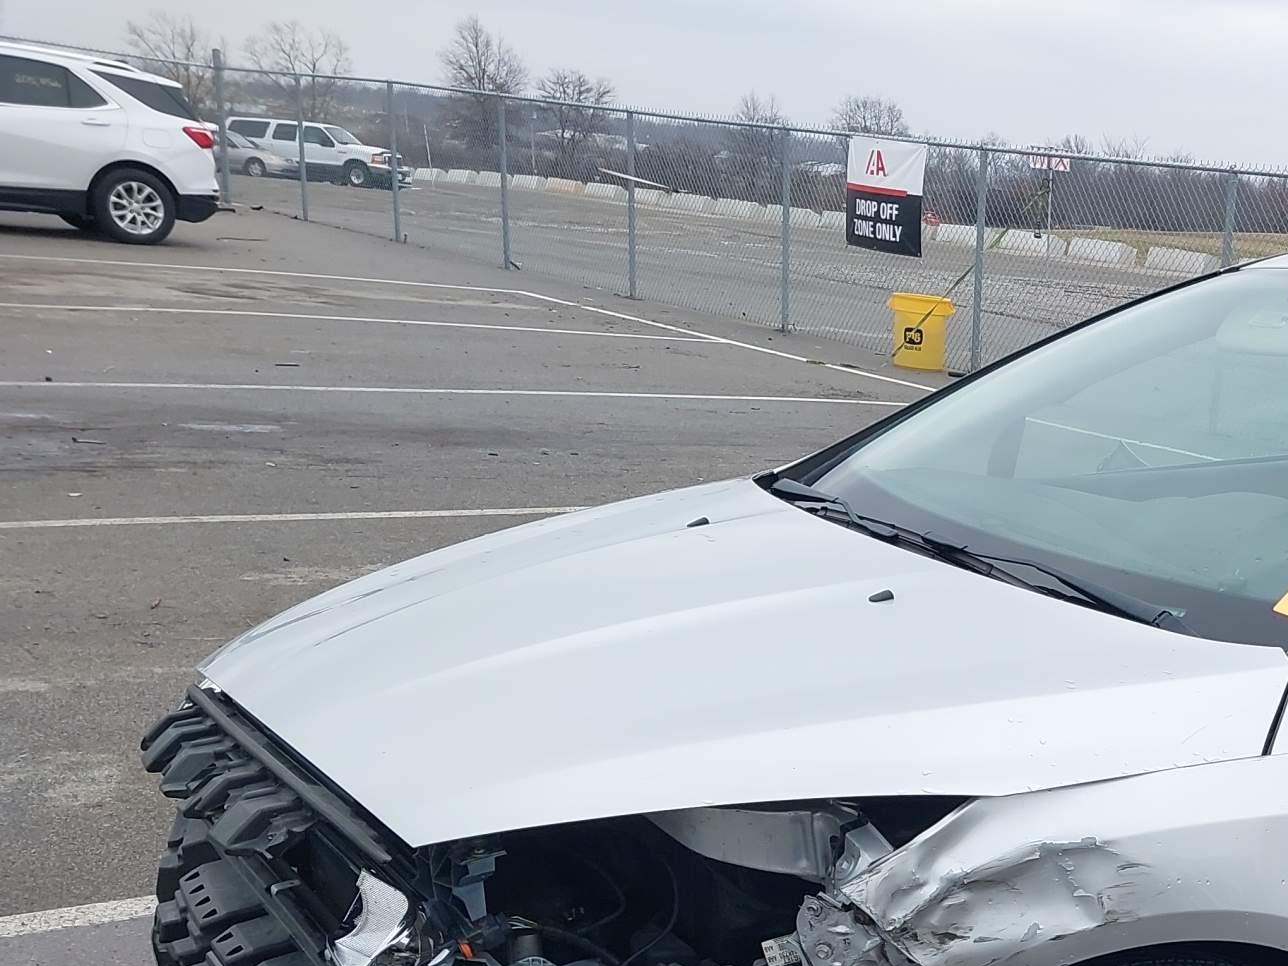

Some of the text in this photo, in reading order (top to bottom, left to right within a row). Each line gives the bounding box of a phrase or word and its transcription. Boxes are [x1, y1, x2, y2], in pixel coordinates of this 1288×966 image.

[855, 198, 900, 221] DROP OFF
[853, 219, 902, 242] ZONE ONLY
